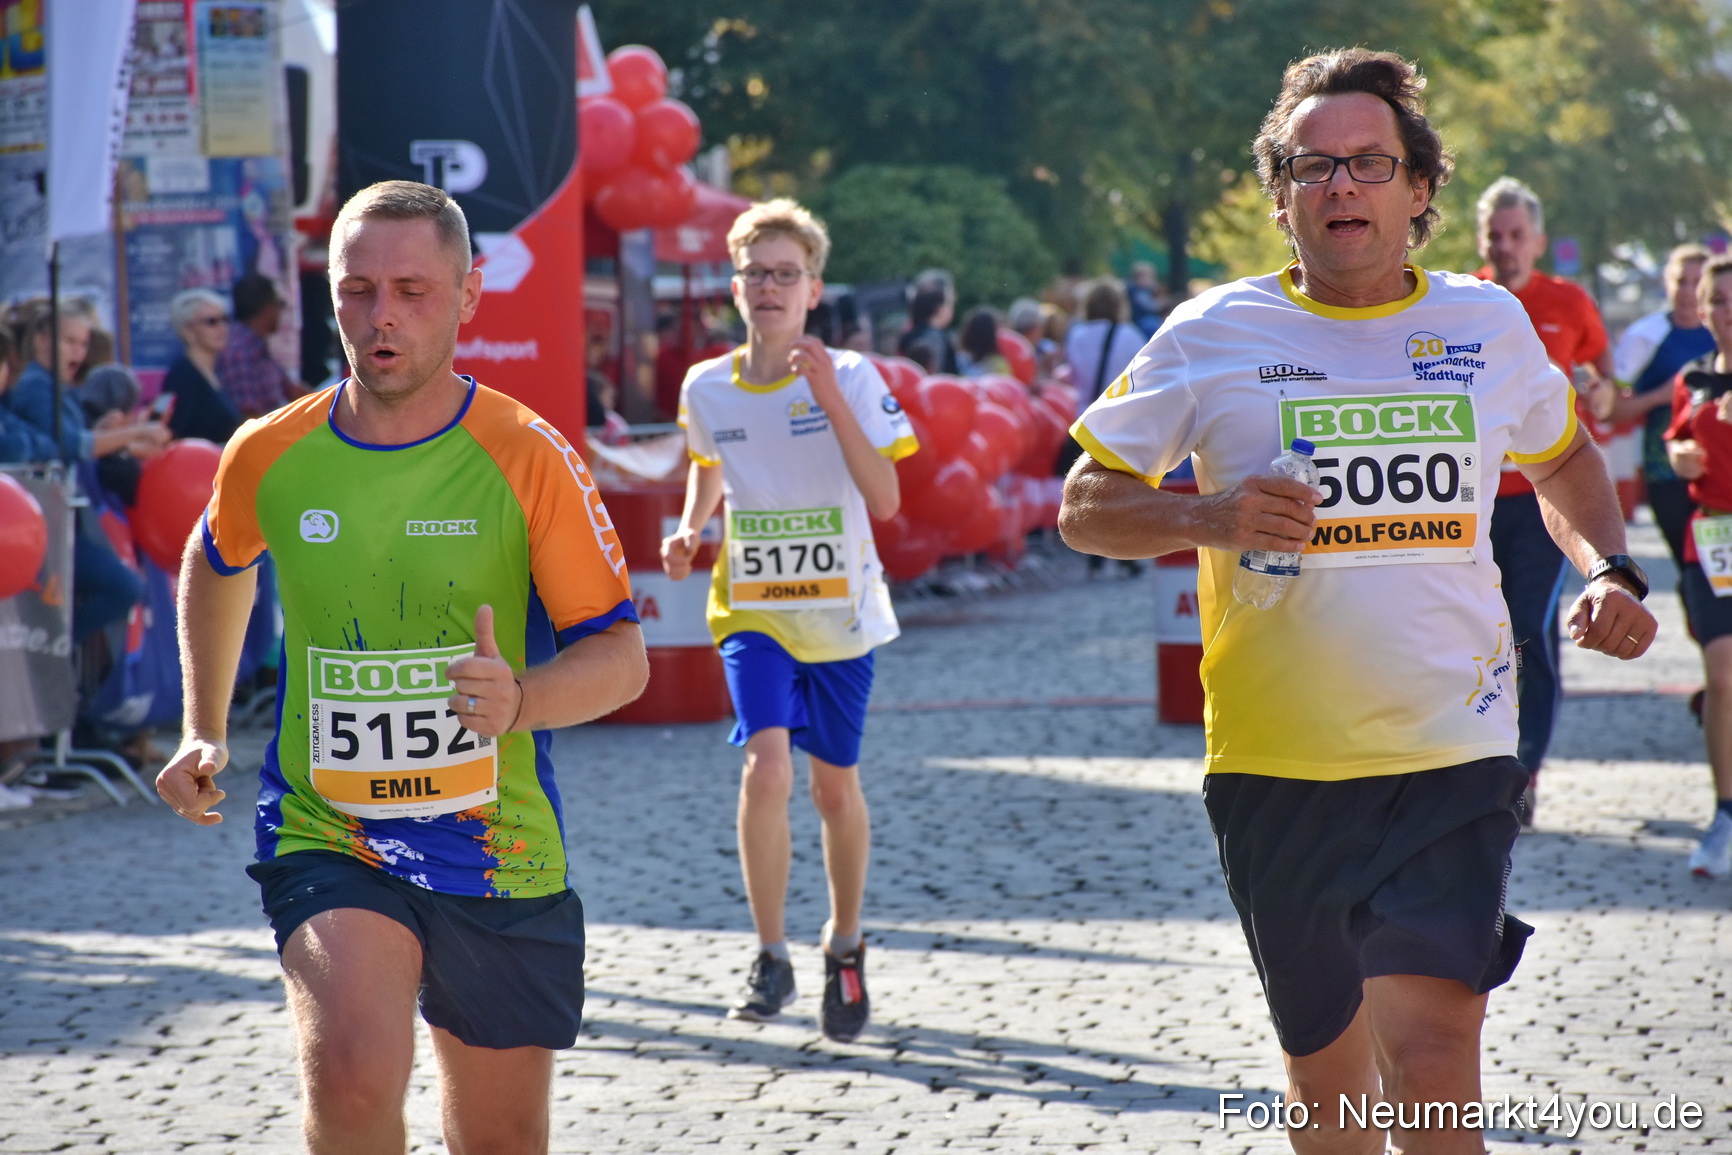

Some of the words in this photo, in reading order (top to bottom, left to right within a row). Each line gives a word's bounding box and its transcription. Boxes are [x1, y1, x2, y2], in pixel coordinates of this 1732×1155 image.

[1410, 338, 1444, 358] 20
[1259, 363, 1327, 379] BOC
[1412, 356, 1486, 371] Neumarkter
[1415, 370, 1475, 385] Stadtlauf
[1295, 400, 1463, 440] BOCK
[1312, 452, 1459, 508] 5060
[1463, 457, 1472, 467] S
[406, 519, 478, 535] BOCK
[738, 511, 836, 537] BOCK
[1311, 520, 1462, 546] WOLFGANG
[744, 543, 834, 575] 5170
[761, 584, 820, 599] JONAS
[331, 710, 475, 760] 5152
[370, 776, 441, 799] EMIL
